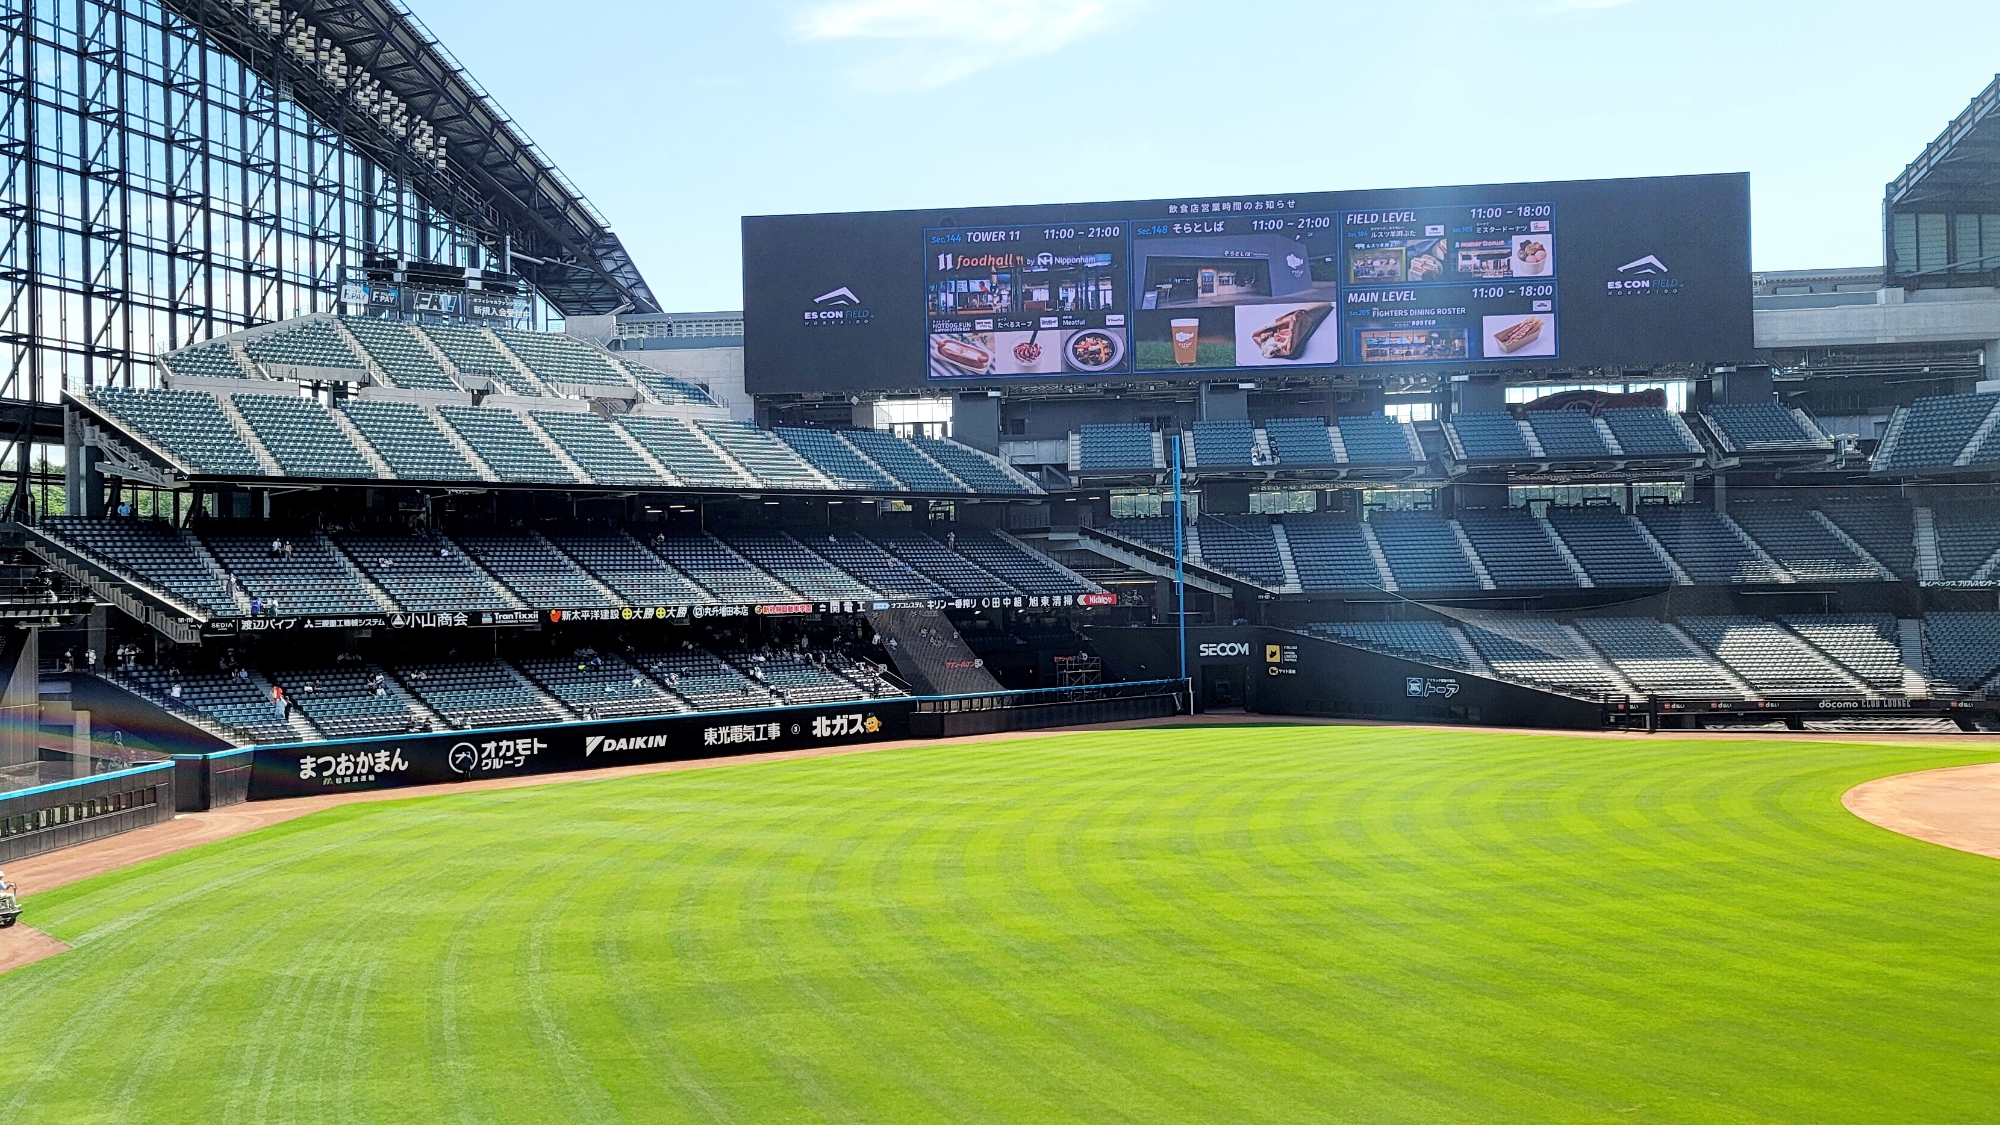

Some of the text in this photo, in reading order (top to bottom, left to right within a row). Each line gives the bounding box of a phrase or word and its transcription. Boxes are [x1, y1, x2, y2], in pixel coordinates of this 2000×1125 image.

[1168, 199, 1296, 214] 飲食店営業時間のお知らせ
[1470, 207, 1502, 219] 11:00
[1516, 205, 1551, 217] 18:00
[1252, 219, 1284, 231] 11:00
[1297, 217, 1330, 229] 21:00
[1346, 211, 1417, 225] FIELD LEVEL
[1044, 228, 1074, 240] 11:00
[1088, 226, 1120, 238] 21:00
[1172, 221, 1225, 234] そらとしば
[1476, 225, 1528, 234] ミスタードーナツ
[966, 230, 1021, 243] TOWER 11
[956, 253, 1014, 270] foodhall
[1026, 258, 1035, 266] by
[1054, 255, 1096, 266] Nipponham
[1607, 279, 1678, 289] ES CON FIELD
[1347, 290, 1417, 304] MAIN LEVEL
[1472, 287, 1504, 299] 11:00
[1519, 285, 1553, 297] 18:00
[1607, 288, 1678, 296] HOKKAIDO
[380, 296, 394, 304] PAY
[473, 305, 530, 318] 新規入会受付中
[804, 310, 870, 320] ES CON FIELD
[1372, 307, 1466, 318] FIGHTERS DINING ROSTER
[997, 321, 1033, 329] たべるスープ
[927, 599, 977, 609] キリン一番搾り
[992, 597, 1022, 608] 田中組
[1029, 595, 1073, 607] 旭東清掃
[494, 611, 539, 620] TranTixxii
[561, 610, 620, 621] 新太平洋建設
[632, 608, 654, 619] 大勝
[665, 607, 687, 618] 大勝
[406, 611, 468, 628] 小山商会
[1199, 642, 1249, 656] SECOM
[1424, 682, 1460, 698] トーア
[1818, 698, 1911, 709] docomo CLUB LOUNGE
[812, 713, 865, 738] 北ガス
[704, 723, 781, 746] 東光電気工事
[481, 738, 548, 758] オカモト
[603, 735, 667, 752] DAIKIN
[299, 747, 409, 779] まつおかまん
[481, 756, 525, 770] グループ
